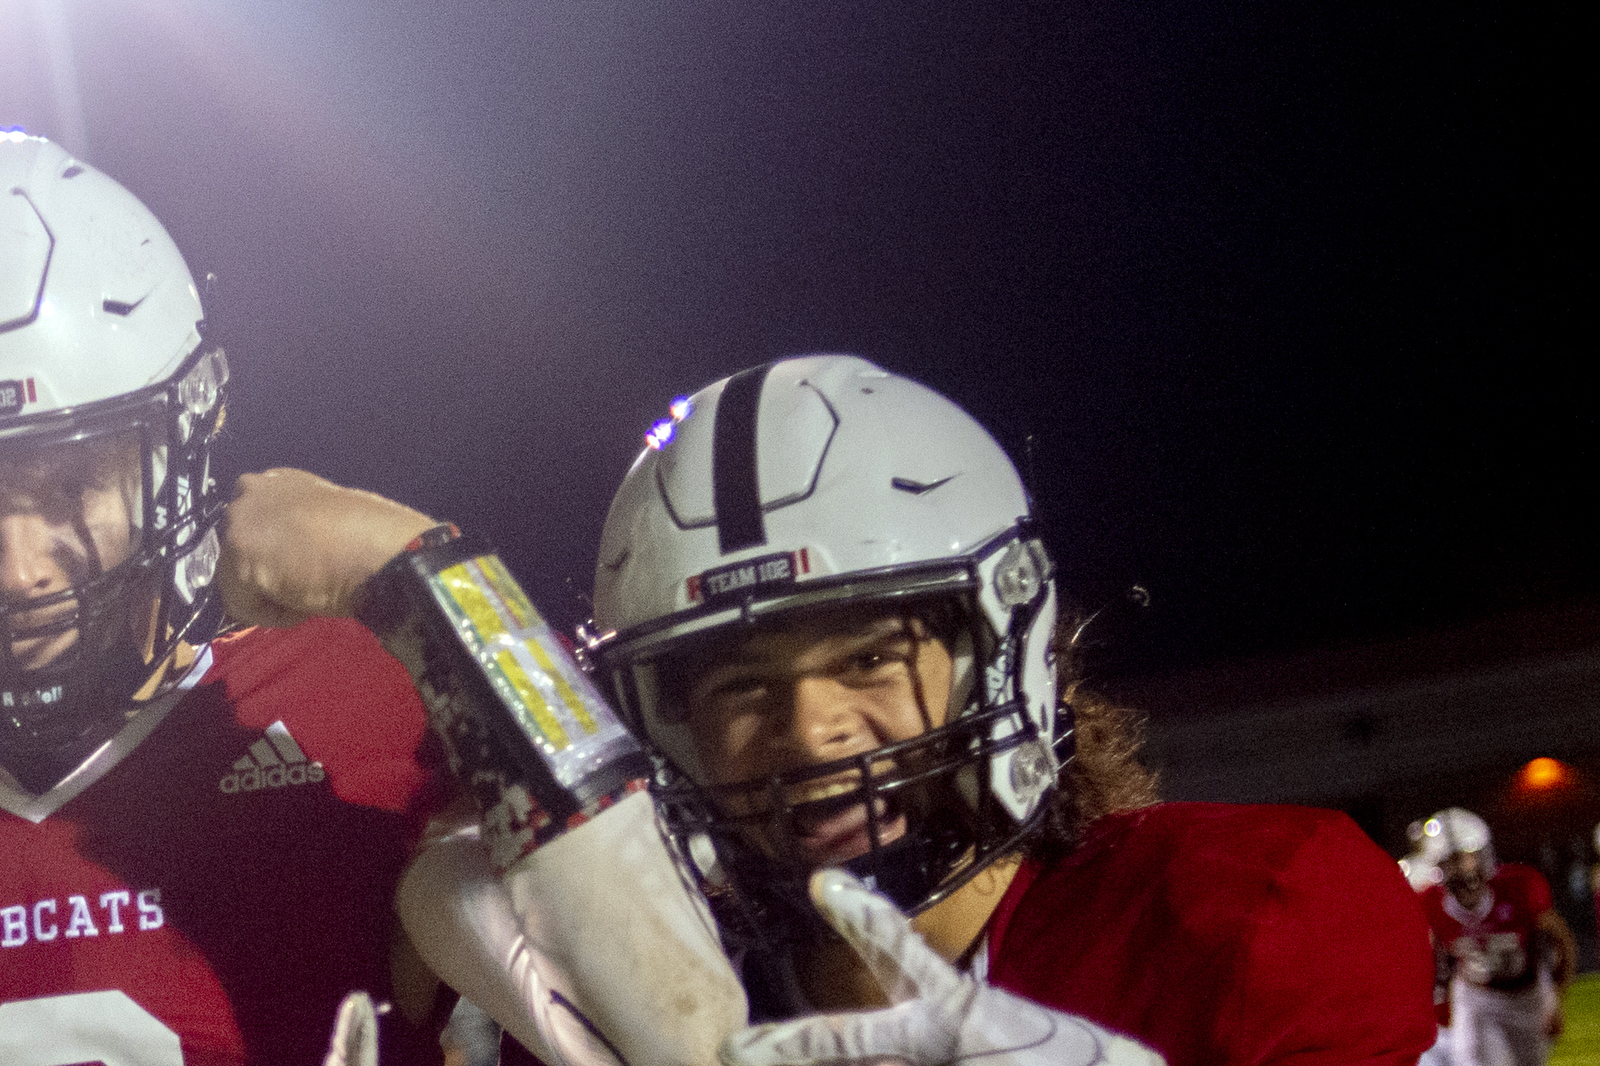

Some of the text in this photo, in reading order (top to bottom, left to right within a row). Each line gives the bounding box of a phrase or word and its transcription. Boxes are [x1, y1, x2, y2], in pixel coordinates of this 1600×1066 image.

[707, 557, 790, 595] TEAM 102
[219, 761, 325, 794] adidas
